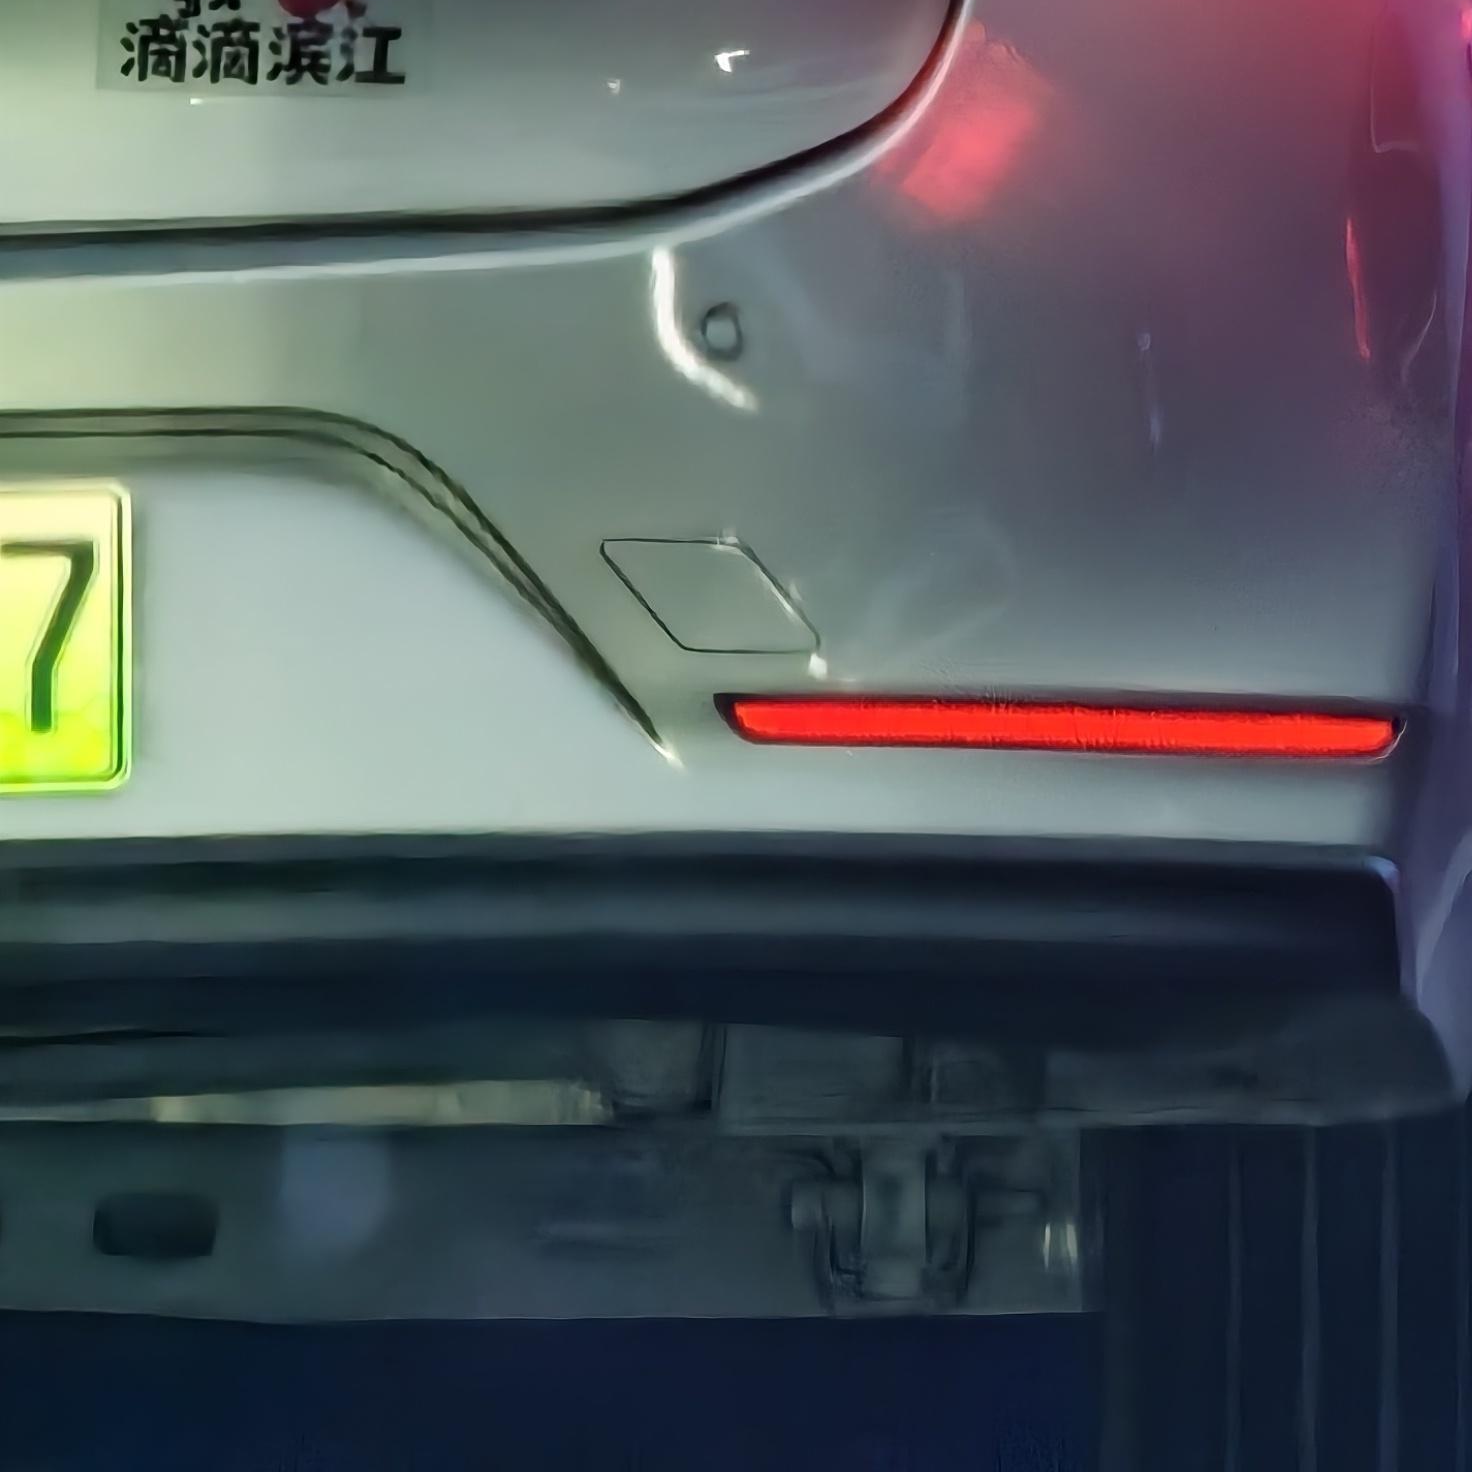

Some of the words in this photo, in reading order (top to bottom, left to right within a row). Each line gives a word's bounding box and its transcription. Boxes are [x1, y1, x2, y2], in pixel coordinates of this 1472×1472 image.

[119, 14, 406, 85] 滴滴滨江
[0, 541, 94, 733] 7
